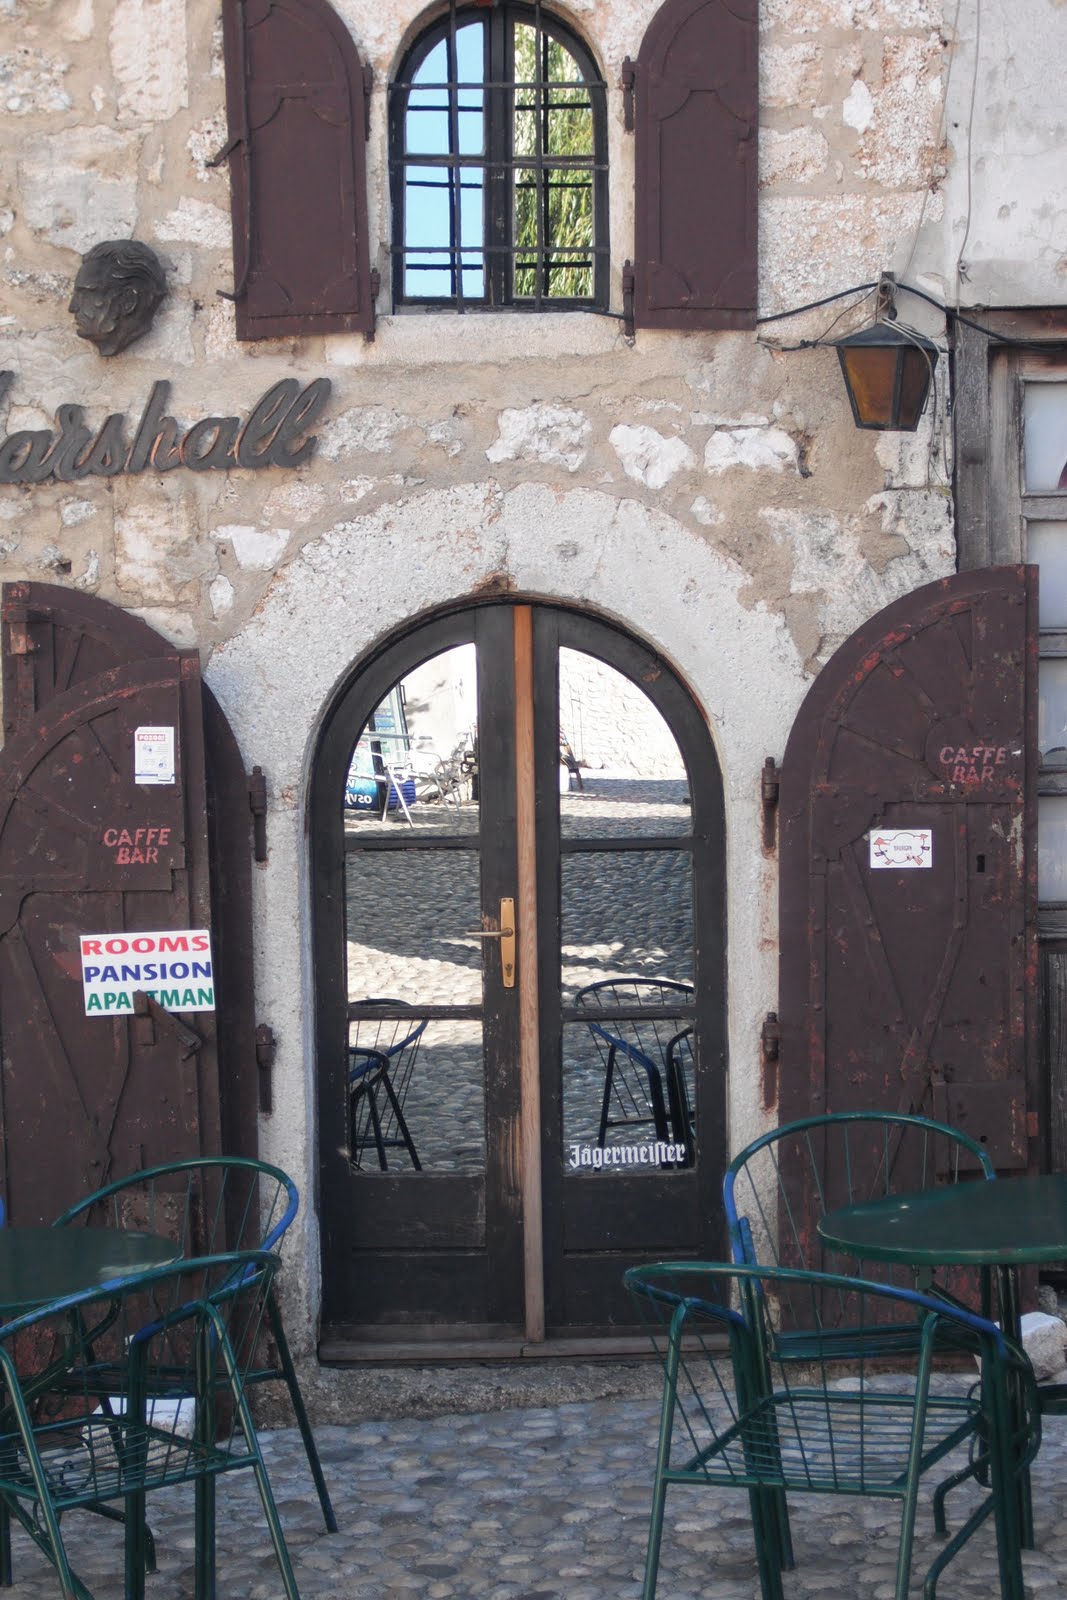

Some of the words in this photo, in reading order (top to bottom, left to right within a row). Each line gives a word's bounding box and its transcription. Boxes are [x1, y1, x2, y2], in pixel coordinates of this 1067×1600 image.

[0, 370, 332, 483] arshall
[939, 746, 1007, 765] CAFFE
[952, 766, 995, 783] BAR
[103, 828, 171, 847] CAFFE
[115, 847, 159, 865] BAR
[82, 935, 209, 956] ROOMS
[84, 961, 212, 983] PANSION
[87, 987, 214, 1011] APATMAN
